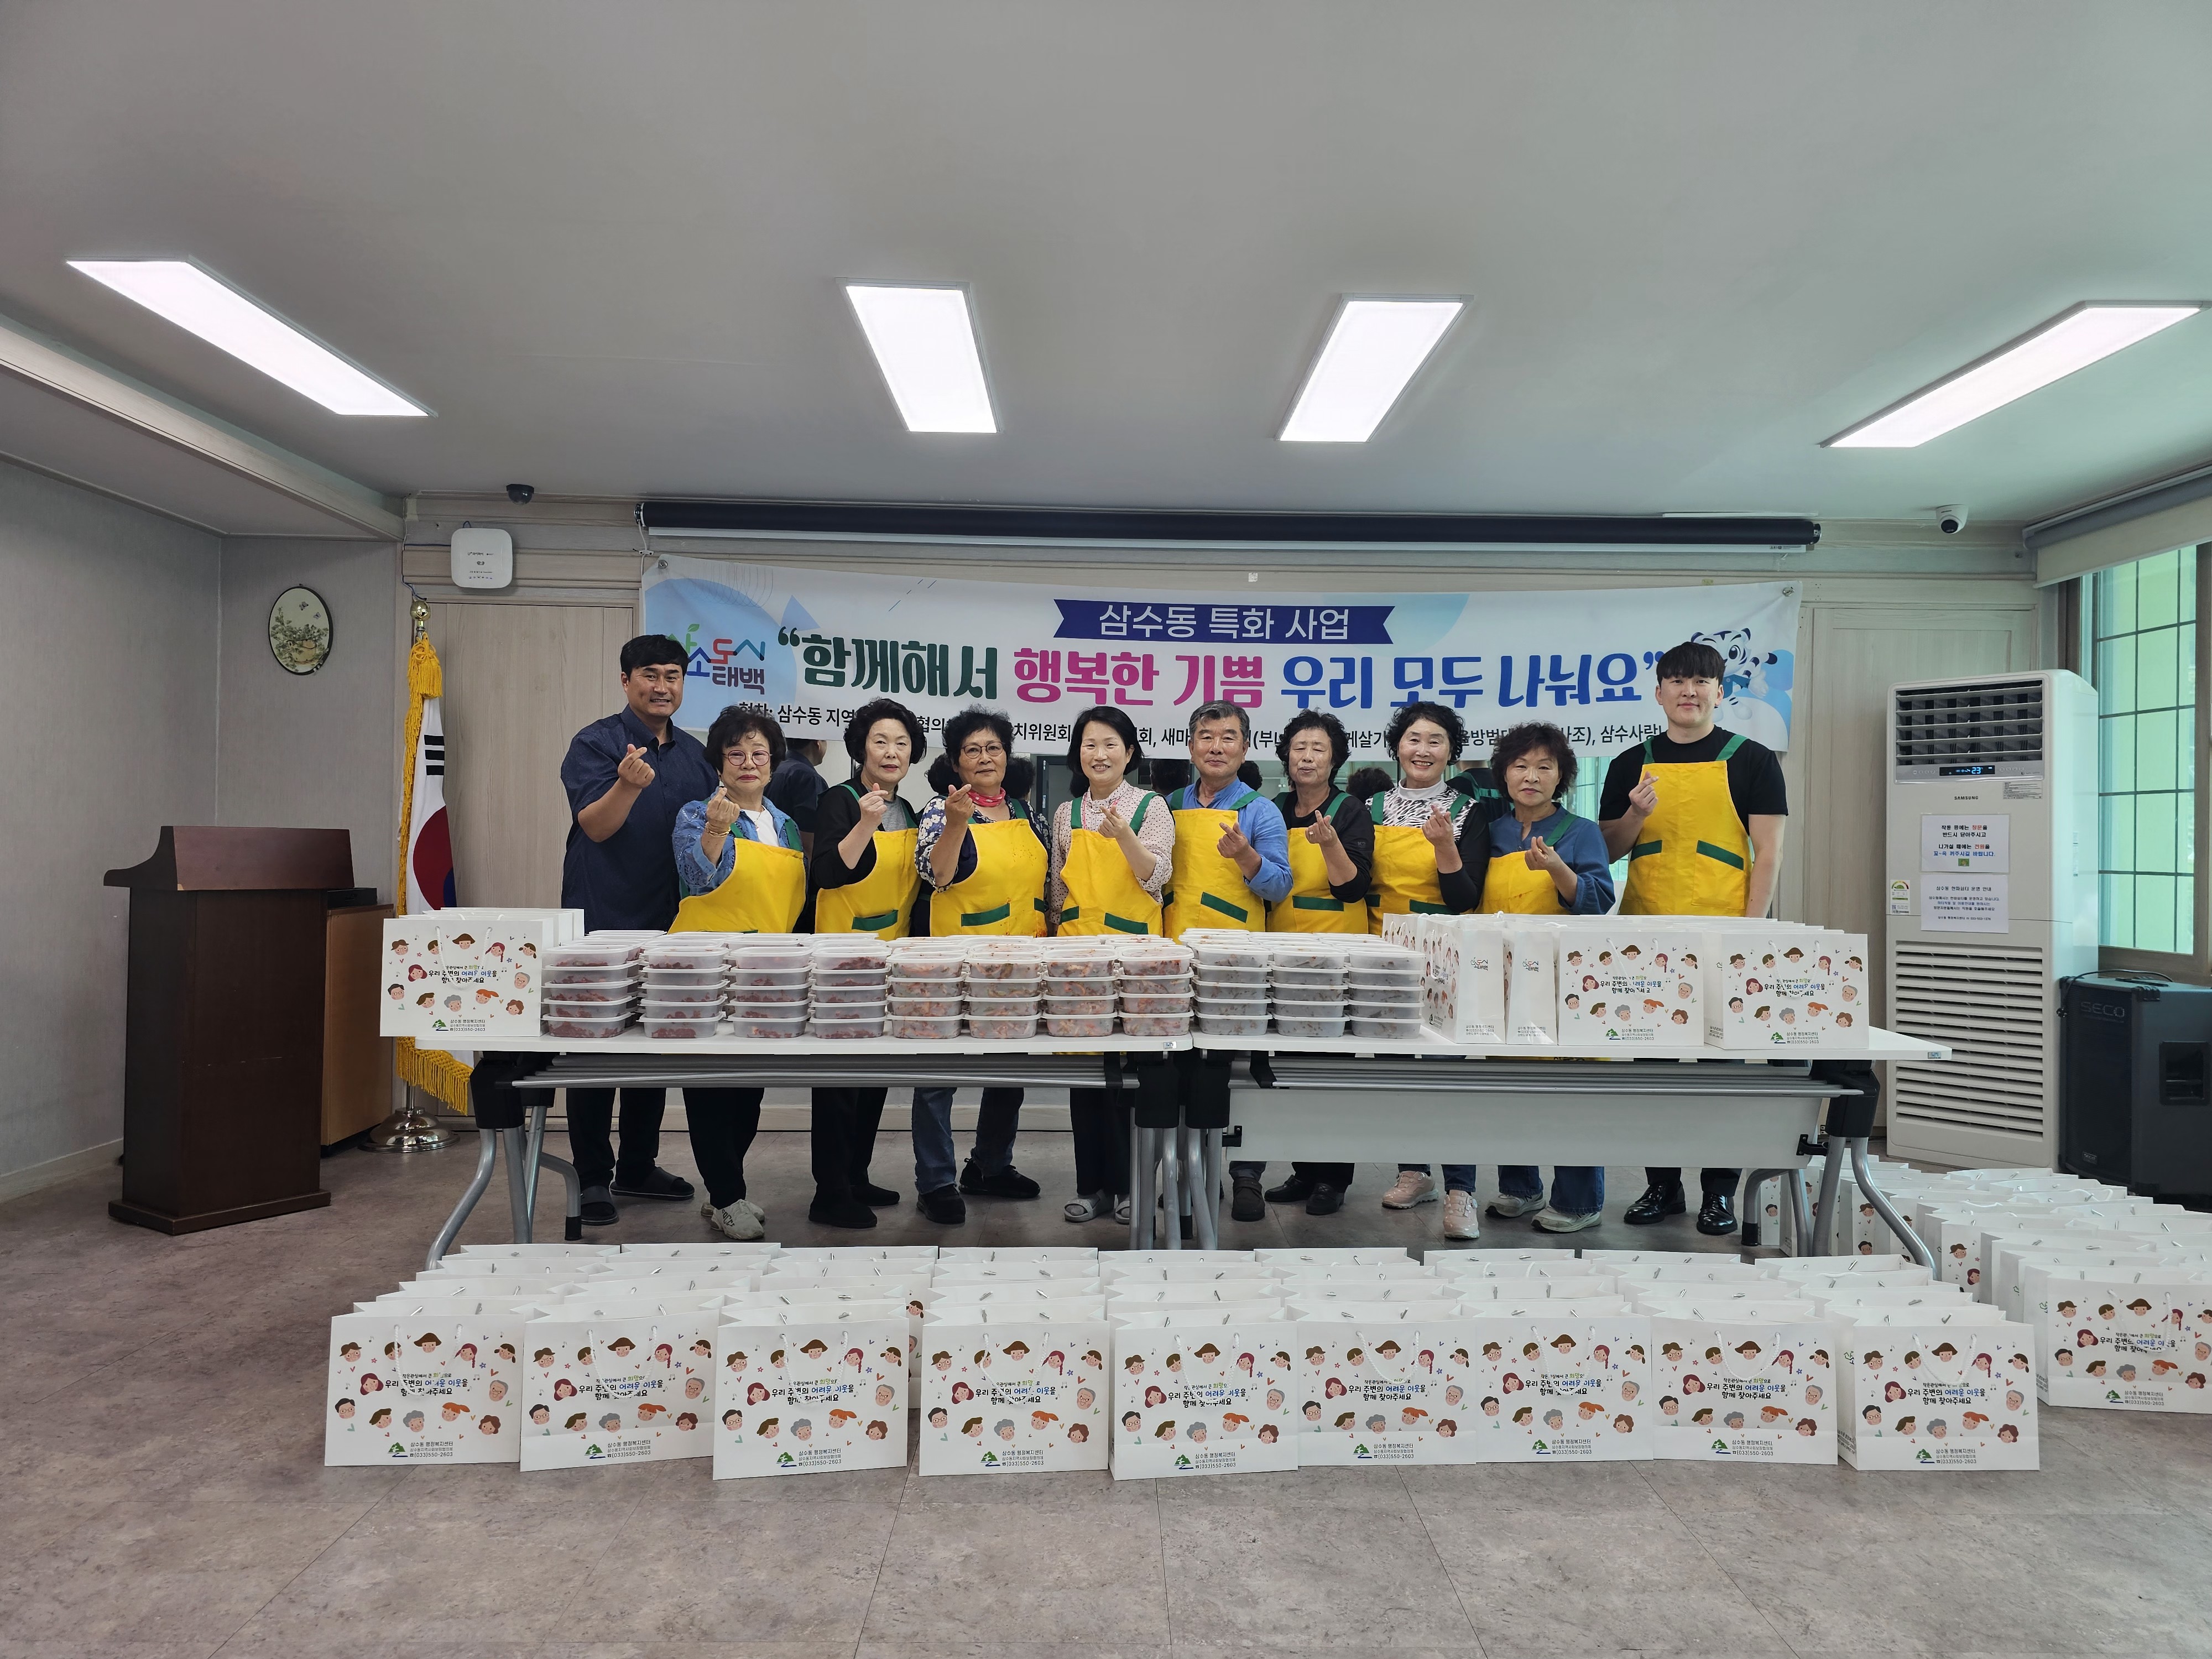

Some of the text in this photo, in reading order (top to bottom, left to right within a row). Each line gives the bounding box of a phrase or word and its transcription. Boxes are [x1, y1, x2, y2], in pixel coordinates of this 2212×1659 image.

[1099, 604, 1349, 640] 삼수동 특화 사업
[778, 626, 998, 700] “함께해서
[1014, 647, 1160, 706] 행복한
[1173, 655, 1265, 708] 기쁨
[1281, 655, 1373, 709] 우리
[1390, 656, 1484, 708] 모두
[712, 666, 765, 695] 태백
[778, 705, 822, 726] 삼수동
[1014, 722, 1071, 742] 치위원회
[1135, 727, 1157, 748] 회,
[385, 1378, 468, 1389] 우리 이웃을
[578, 1385, 593, 1394] 우리
[643, 1379, 664, 1389] 이웃을
[1525, 1380, 1538, 1388] 우리
[1583, 1379, 1601, 1387] 이웃을
[1707, 1383, 1720, 1391] 우리
[1745, 1384, 1765, 1392] 어려운
[1767, 1384, 1786, 1392] 이웃을
[771, 1389, 785, 1397] 우리
[975, 1386, 1056, 1397] 우리 이웃을
[1348, 1384, 1426, 1394] 우리 주변의 어려운 이웃을
[1540, 1387, 1553, 1396] 함께
[1907, 1388, 1986, 1397] 우리 주변의 어려운 이웃을
[594, 1392, 610, 1401] 함께
[1168, 1392, 1181, 1401] 우리
[1205, 1389, 1225, 1397] 어려운
[1363, 1393, 1411, 1401] 함께 찾아주세요
[990, 1396, 1005, 1405] 함께
[1183, 1400, 1197, 1408] 함께
[1922, 1397, 1971, 1405] 함께 찾아주세요
[612, 1450, 651, 1458] (033)550-2603
